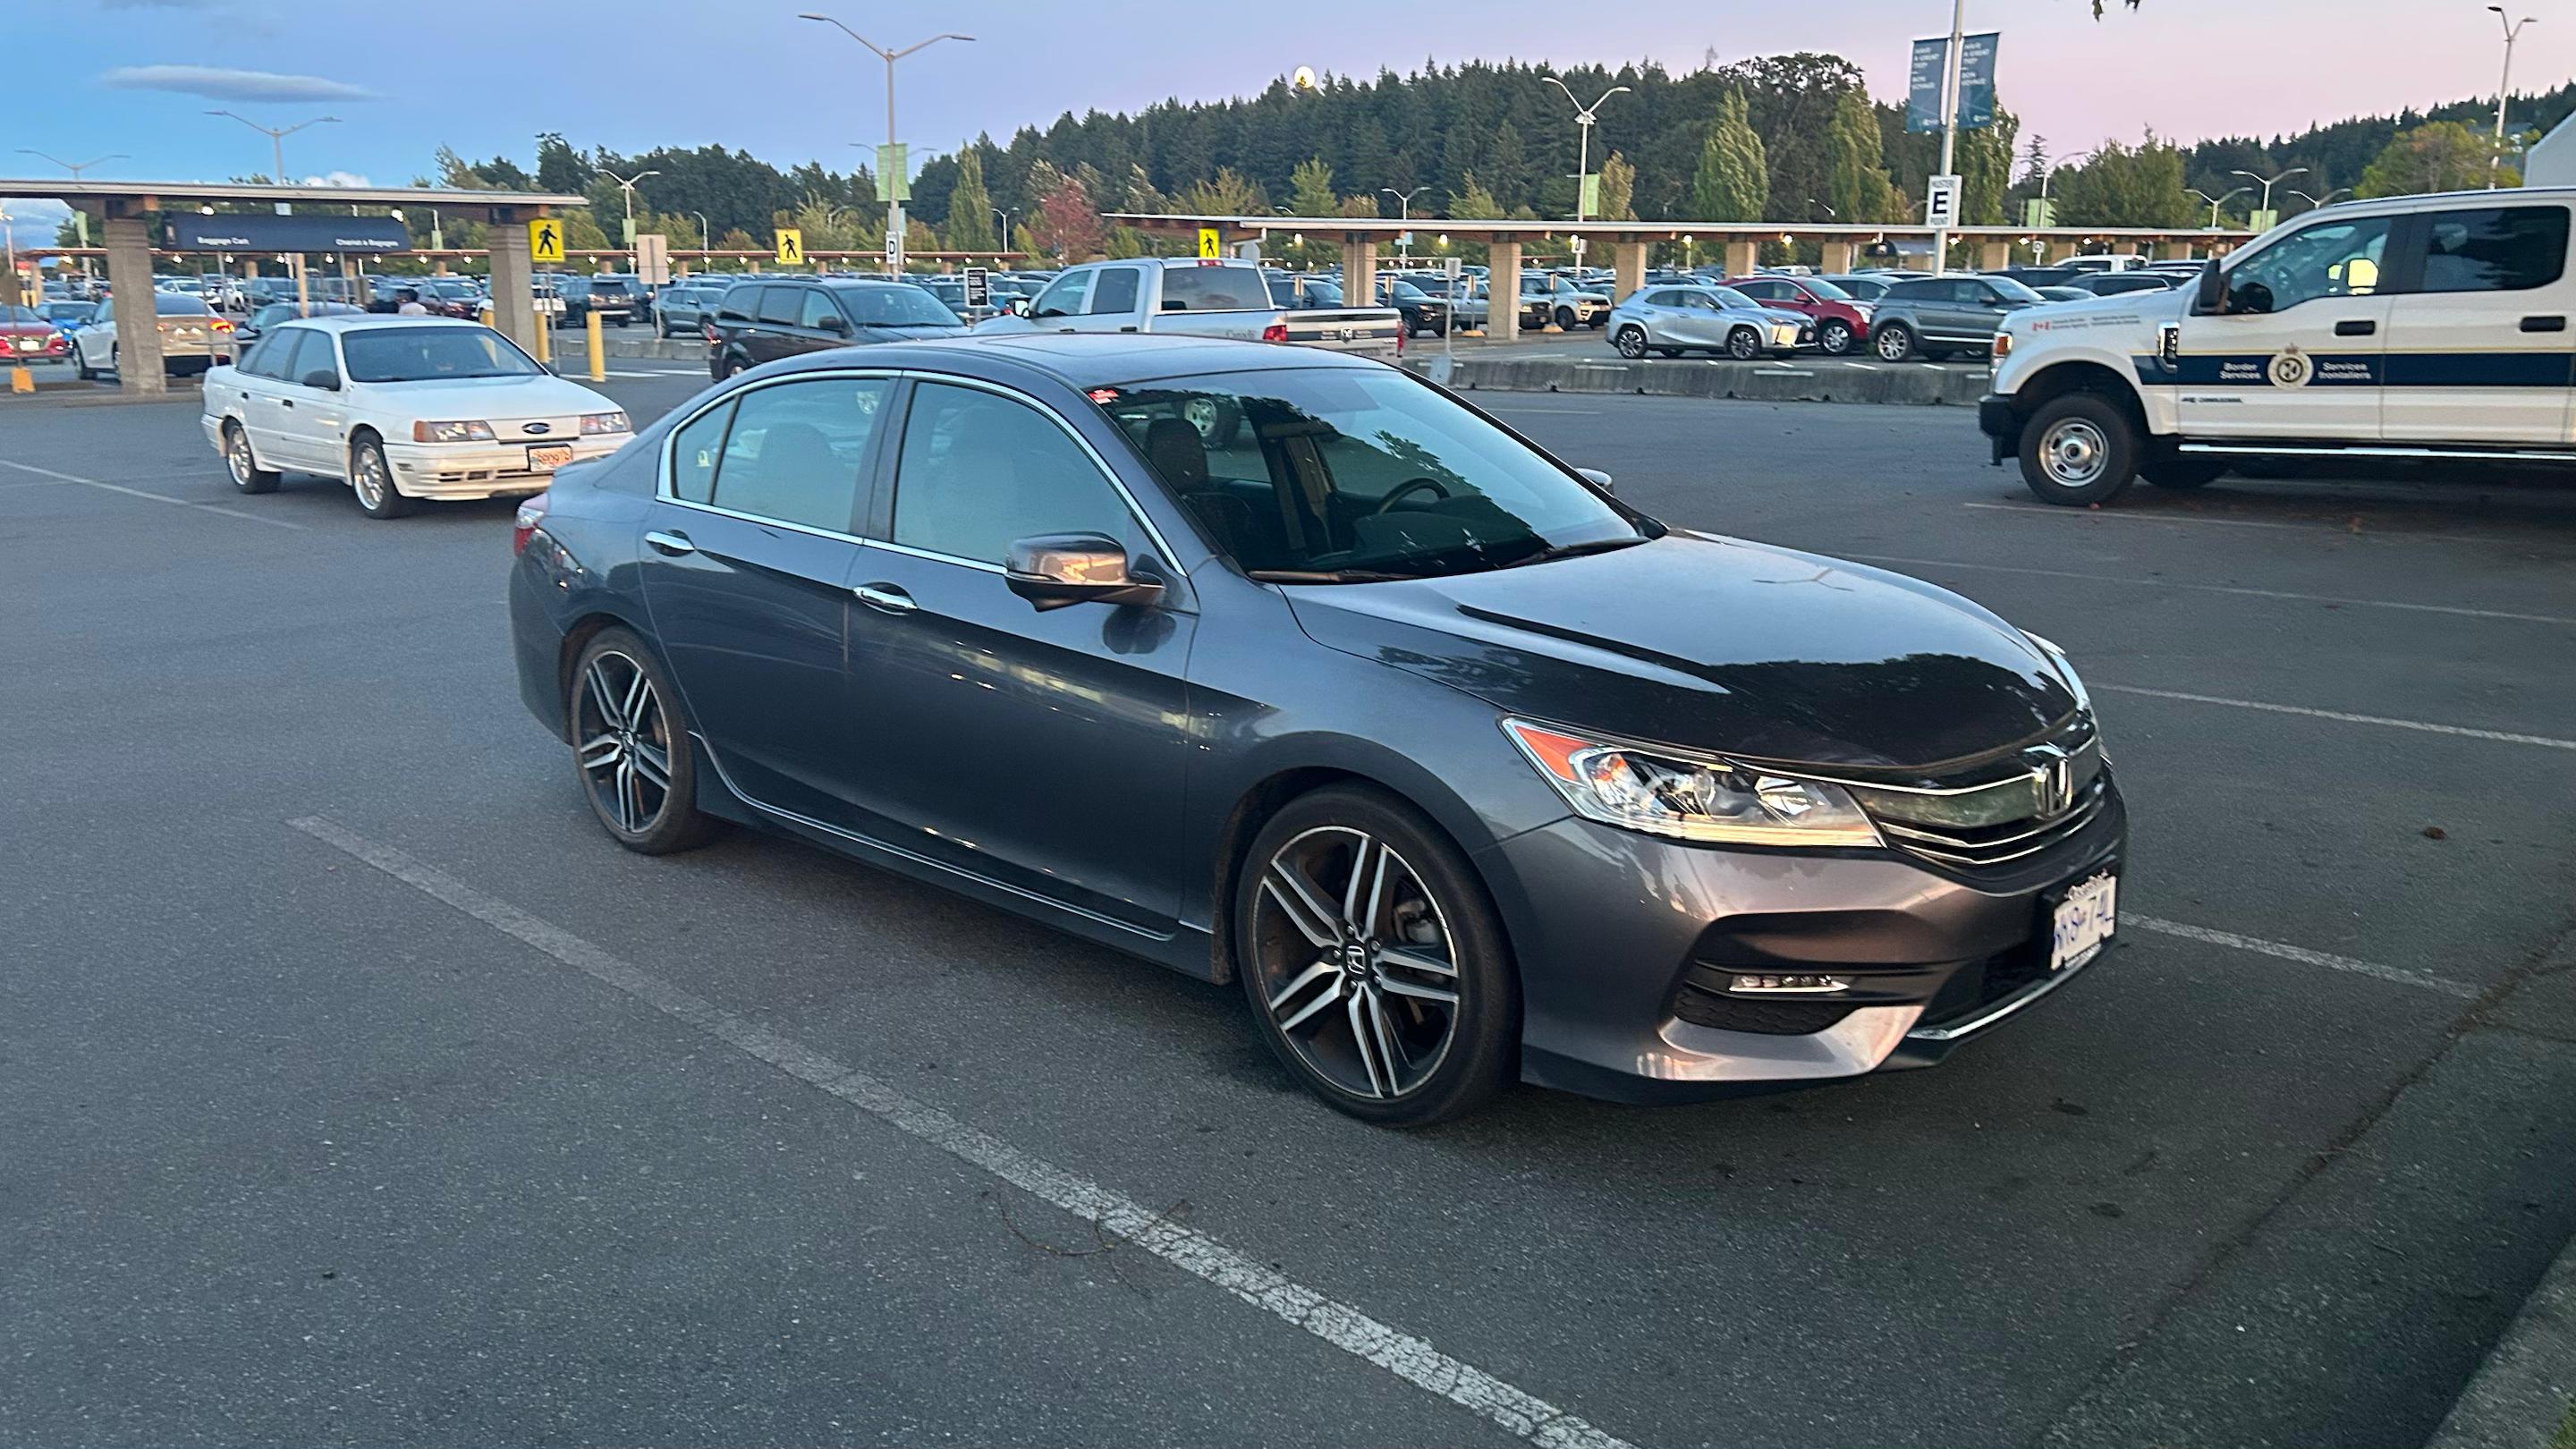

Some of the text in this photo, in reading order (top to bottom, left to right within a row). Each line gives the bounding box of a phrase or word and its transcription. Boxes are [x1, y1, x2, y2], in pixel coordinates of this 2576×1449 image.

[1932, 191, 1948, 215] E
[888, 240, 895, 255] D
[2224, 361, 2258, 371] Border
[2322, 361, 2368, 371] Services
[2219, 370, 2262, 380] Services
